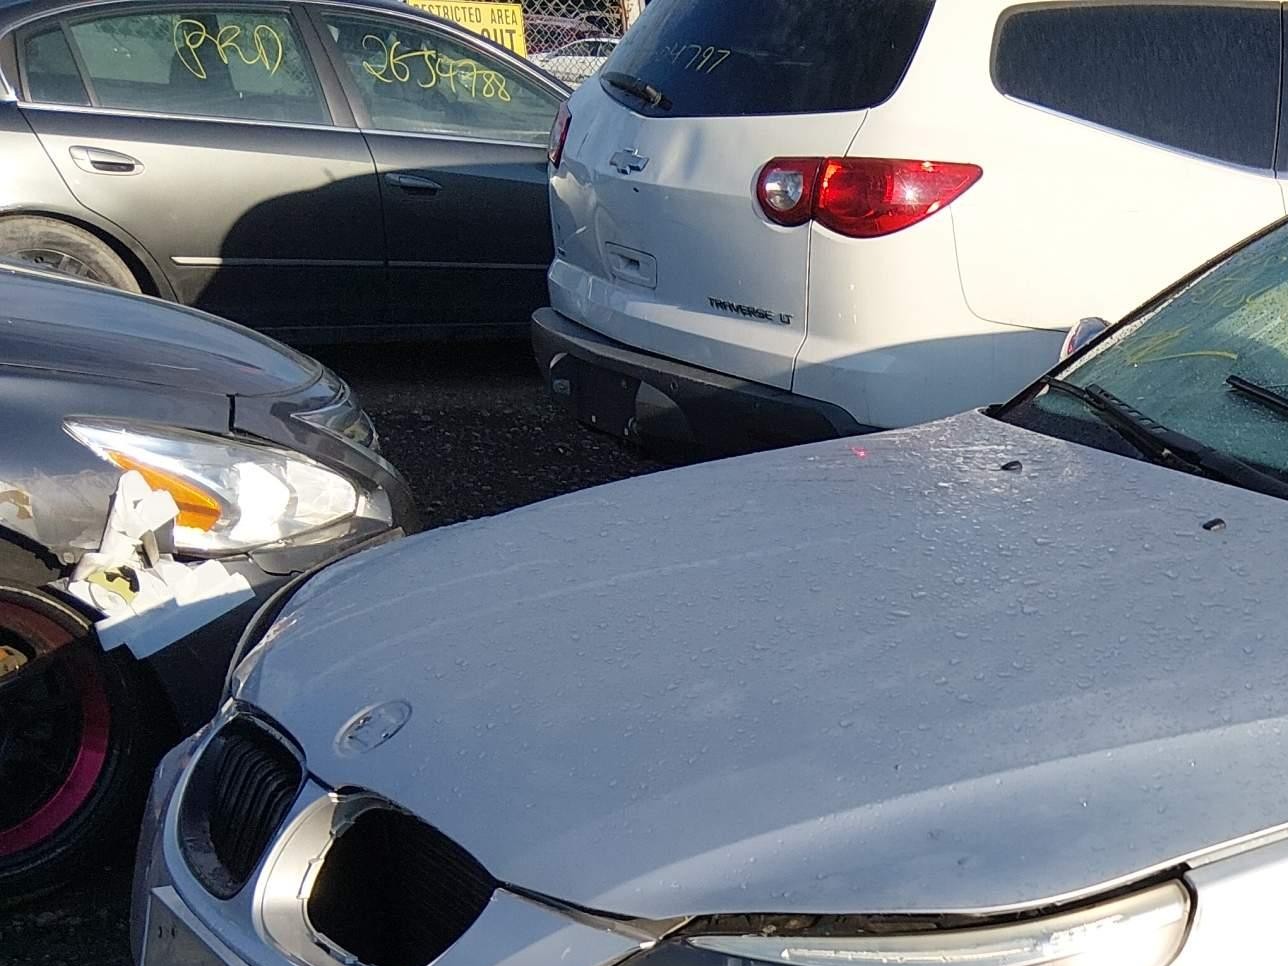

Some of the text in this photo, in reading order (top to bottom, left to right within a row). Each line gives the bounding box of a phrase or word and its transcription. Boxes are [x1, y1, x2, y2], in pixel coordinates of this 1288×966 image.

[490, 8, 518, 25] AREA
[708, 297, 794, 325] TRAVERSE LT
